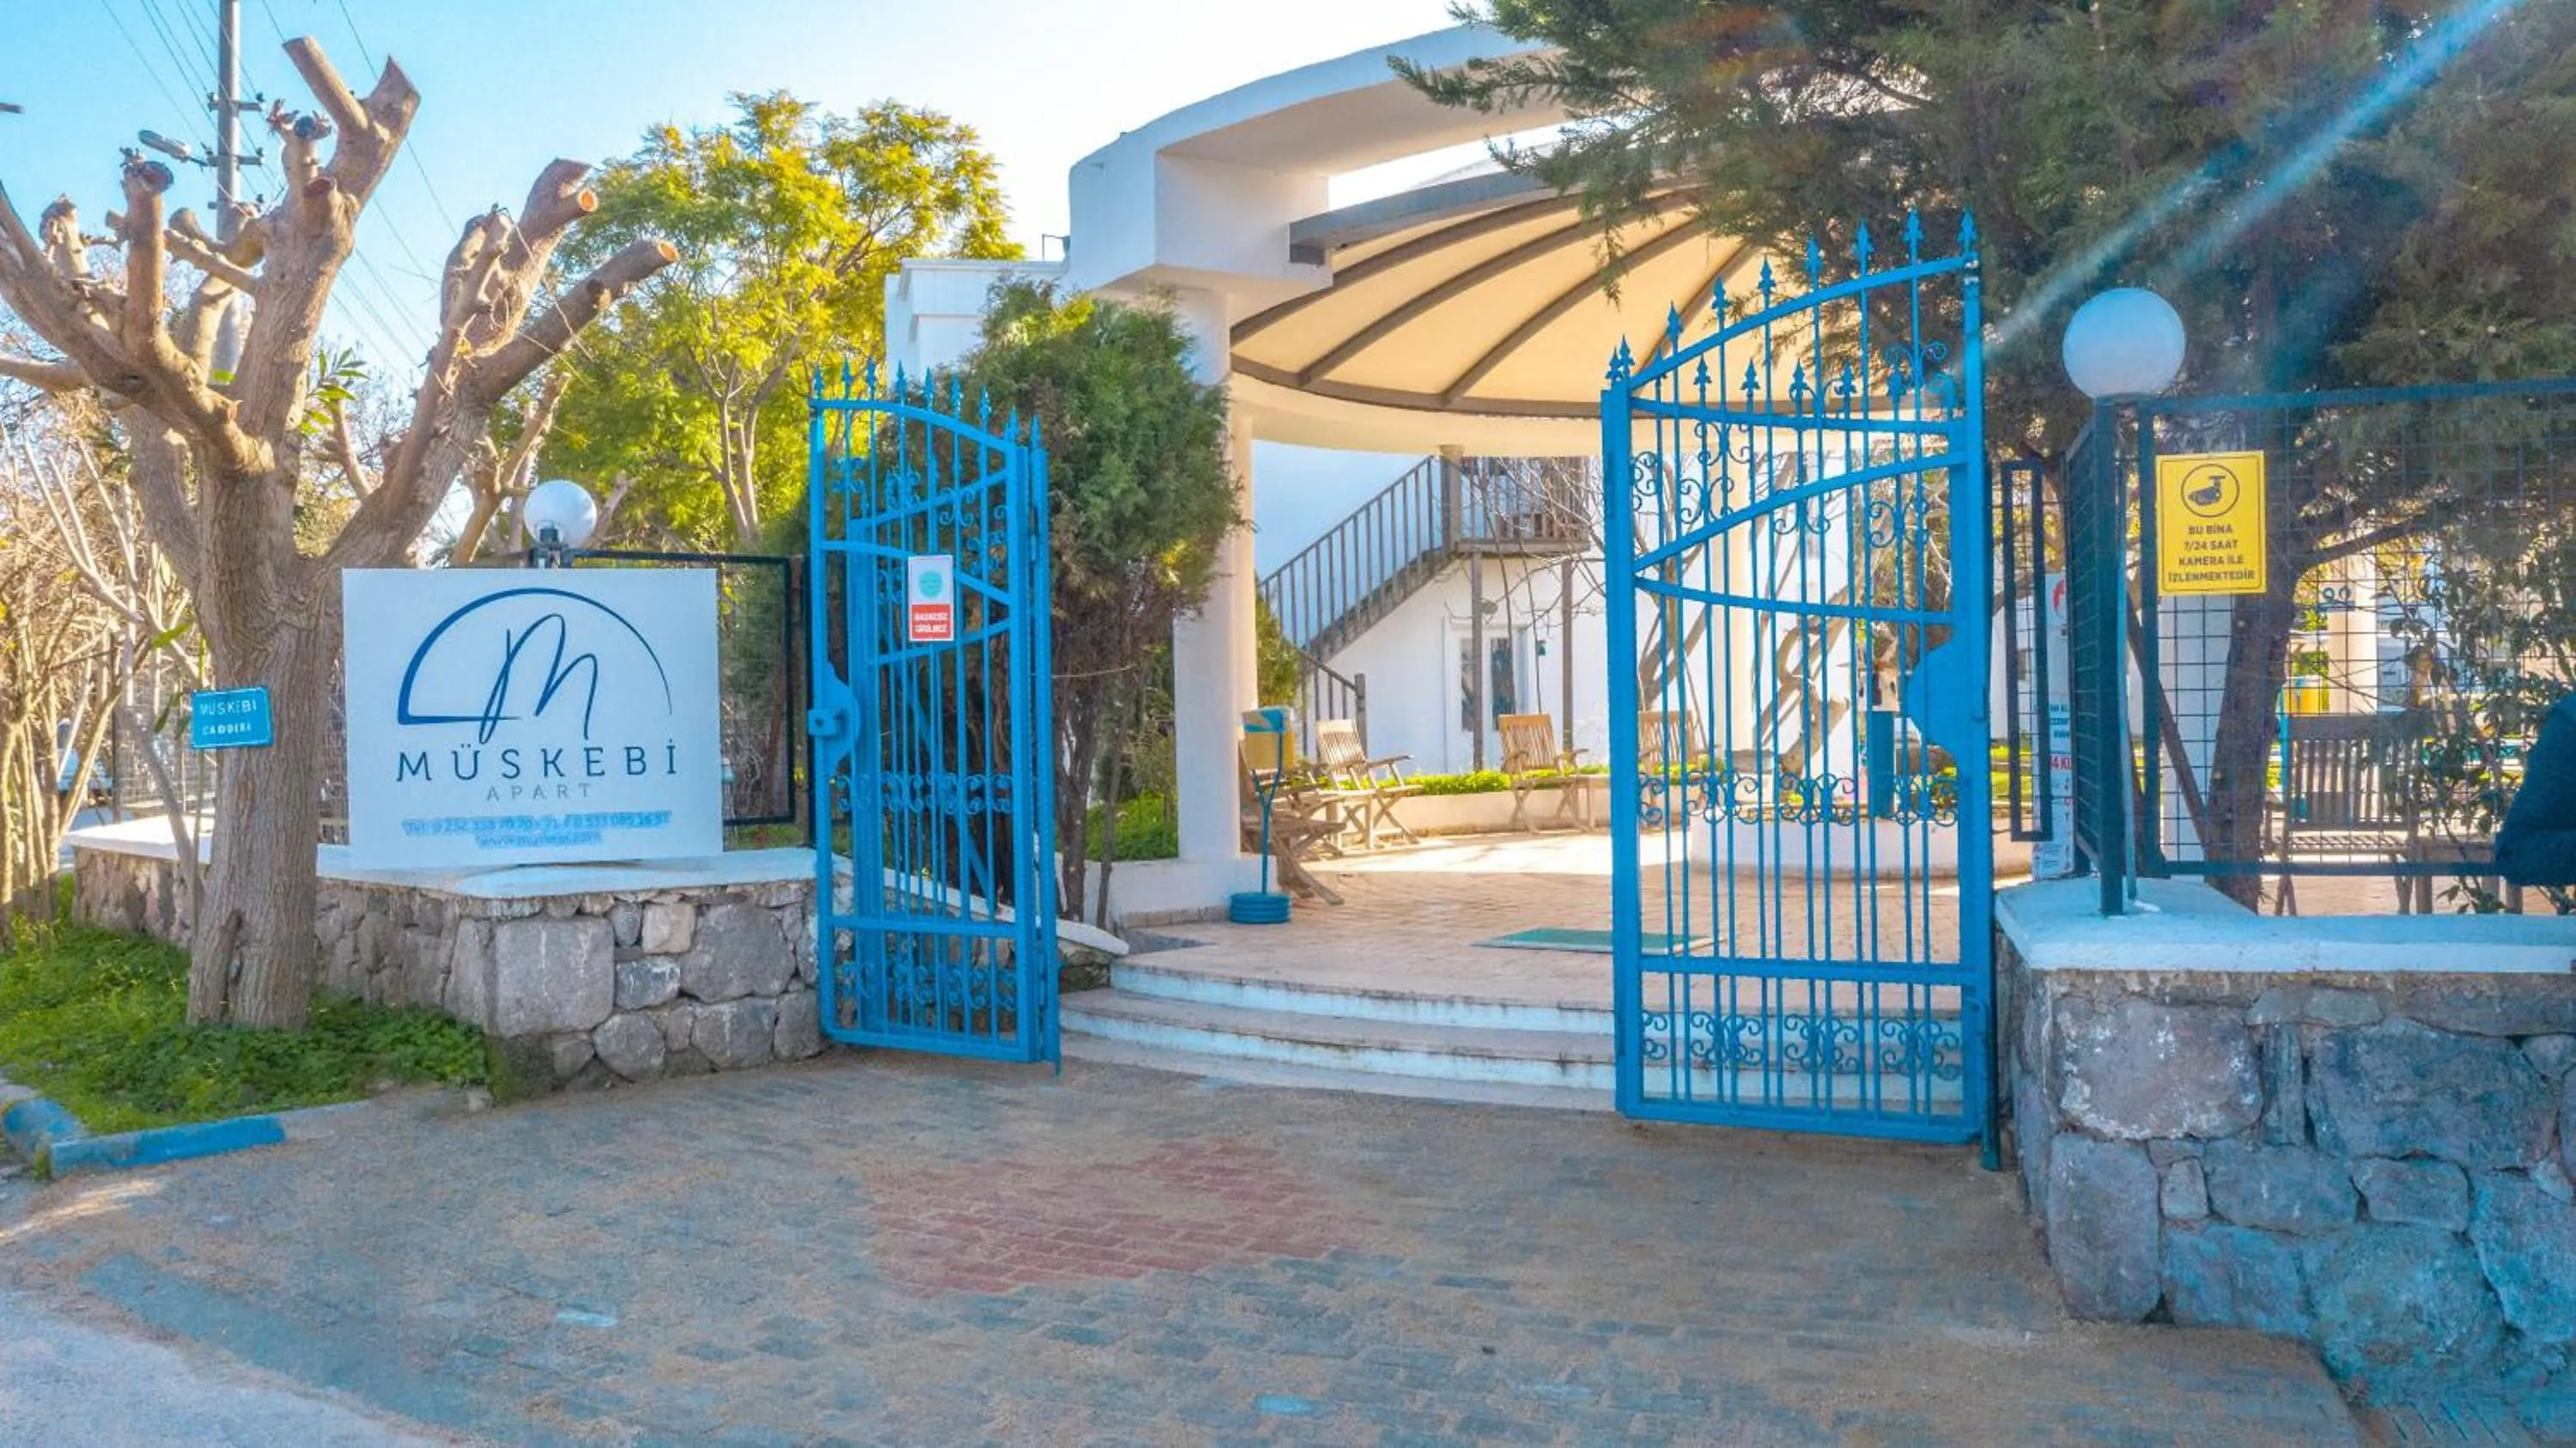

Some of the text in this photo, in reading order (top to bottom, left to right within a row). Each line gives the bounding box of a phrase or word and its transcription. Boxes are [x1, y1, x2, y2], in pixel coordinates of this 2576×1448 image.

[2189, 523, 2233, 534] BU BİNA
[2184, 539, 2238, 551] 7/24 SAAT
[2179, 554, 2244, 566] KAMERA İLE
[2169, 569, 2254, 581] İZLENMEKTEDİR
[396, 738, 677, 782] MÜSKEBİ
[486, 782, 593, 802] APART
